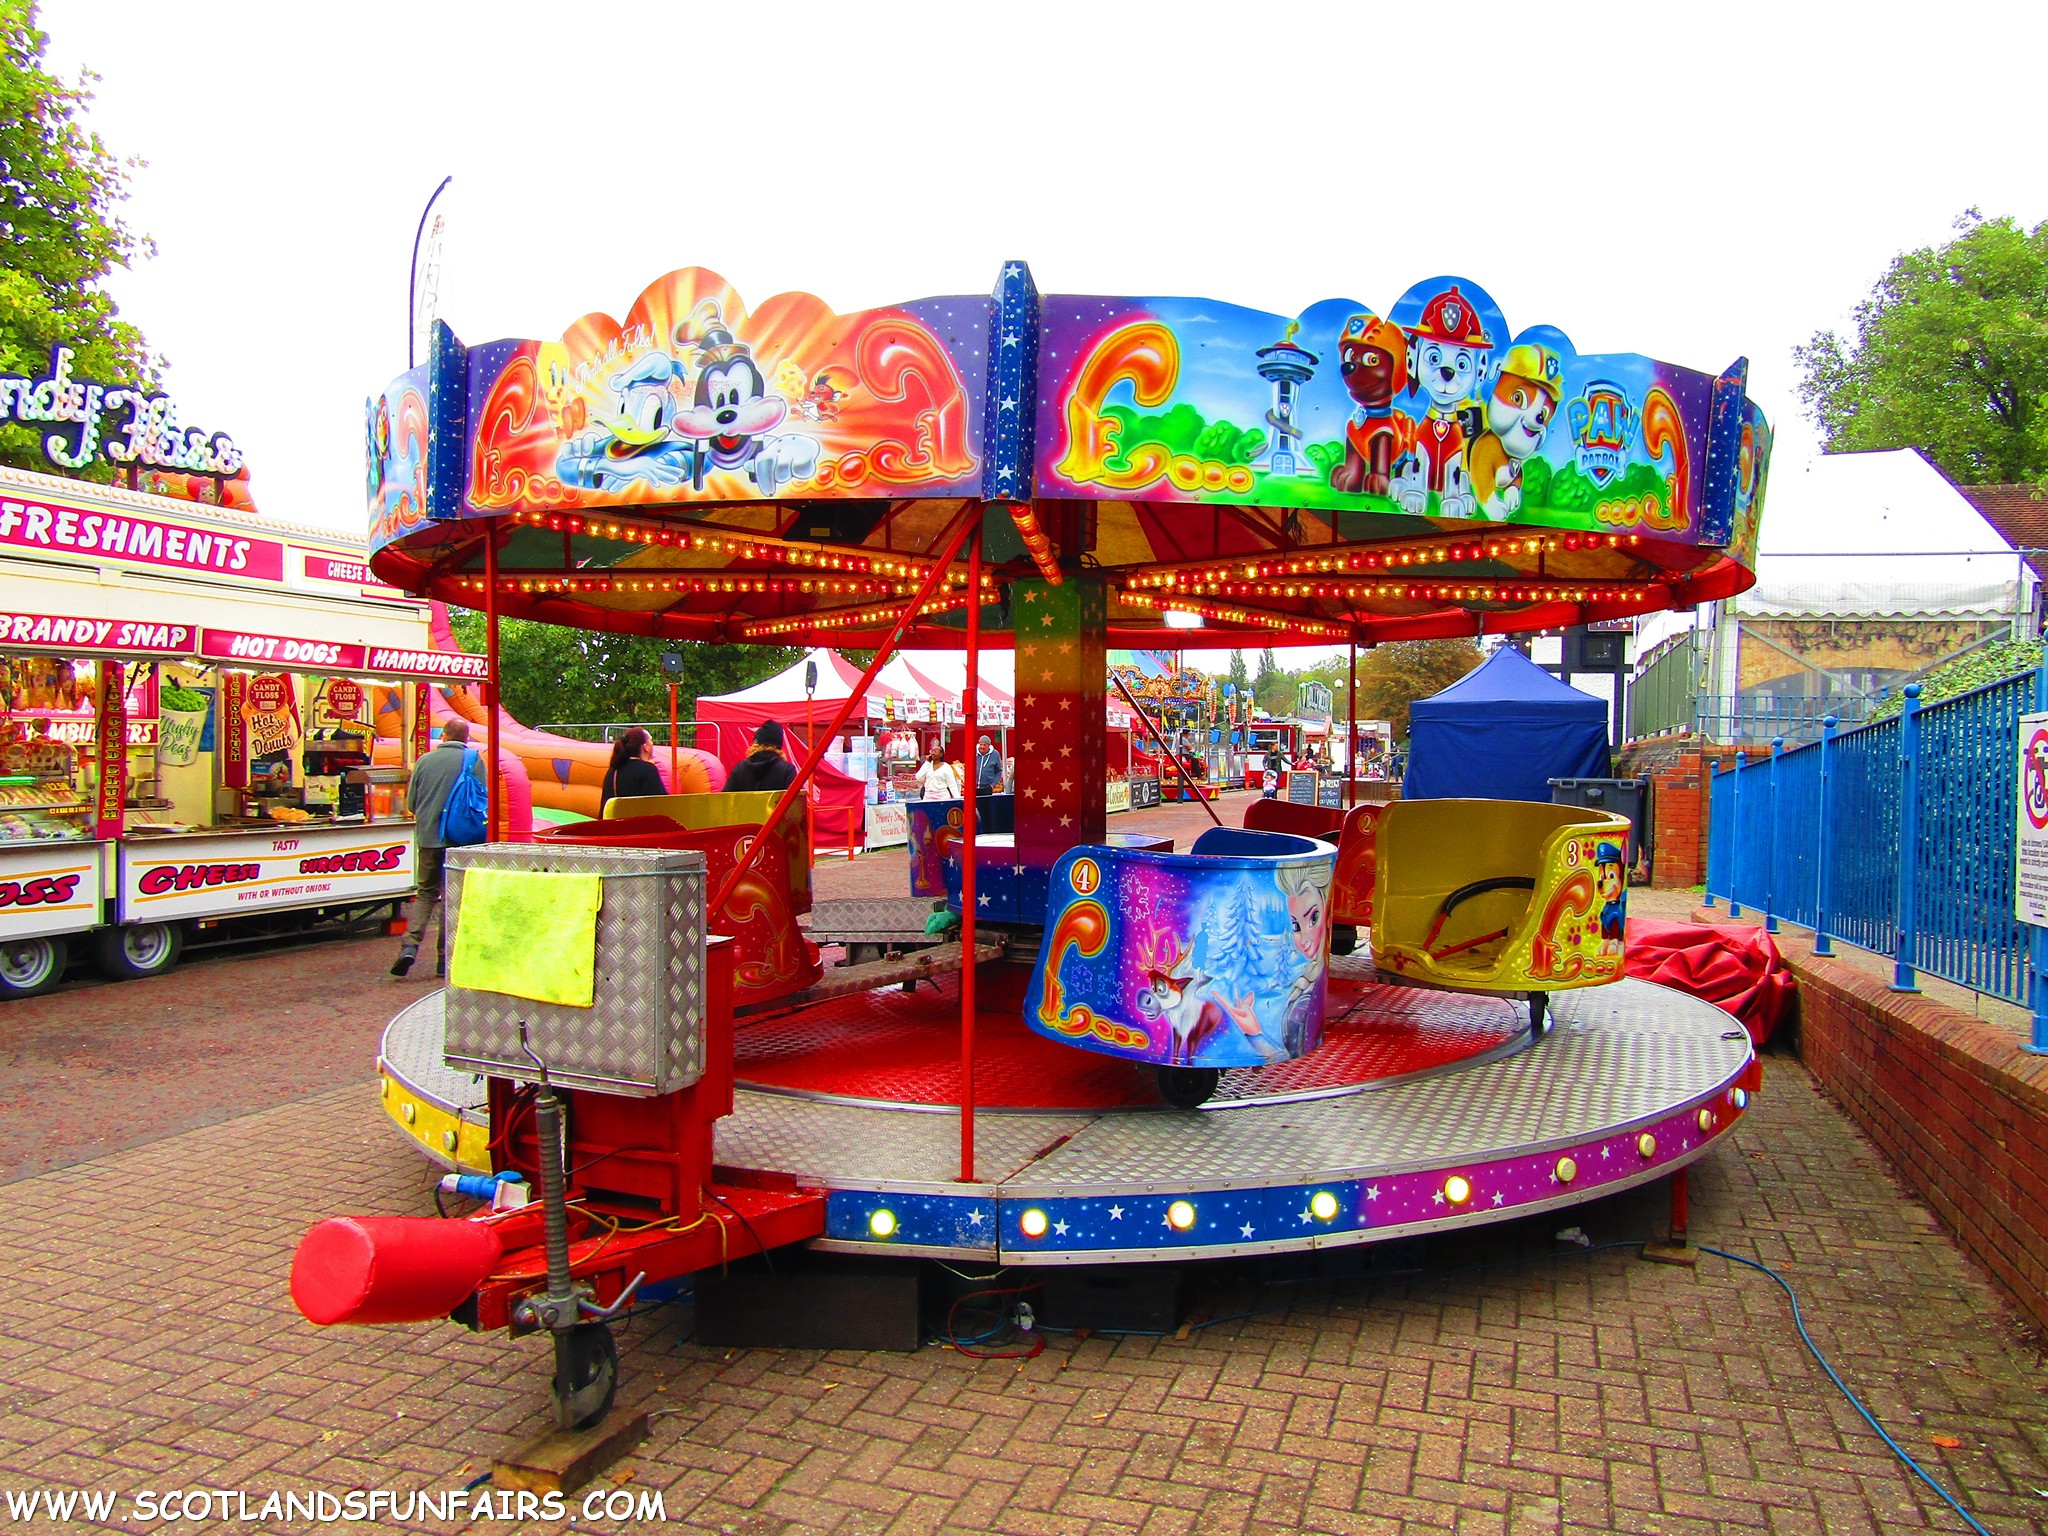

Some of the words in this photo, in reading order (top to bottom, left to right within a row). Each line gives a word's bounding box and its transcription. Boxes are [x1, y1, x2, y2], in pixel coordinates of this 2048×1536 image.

[1567, 397, 1641, 450] PAW
[327, 561, 363, 580] CHEESE
[117, 623, 188, 649] SNAP
[231, 634, 279, 659] HOT
[282, 640, 342, 665] DOGS
[253, 683, 281, 692] CANDY
[255, 691, 280, 700] FLOSS
[333, 686, 358, 694] CANDY
[334, 693, 356, 701] FLOSS
[230, 699, 241, 727] COLD
[252, 713, 275, 731] Hot
[160, 714, 199, 744] Mushy
[260, 718, 287, 741] Fresh
[160, 732, 191, 760] Peas
[230, 727, 241, 762] SLUSH
[252, 735, 294, 757] Donuts
[953, 811, 958, 824] 1
[1363, 815, 1371, 833] 2
[271, 840, 299, 851] TASTY
[1568, 841, 1577, 866] 3
[138, 863, 261, 895] CHEESE
[299, 845, 406, 874] BURGERS
[1076, 864, 1091, 891] 4
[237, 892, 258, 901] WITH
[259, 890, 270, 899] OR
[271, 887, 303, 898] WITHOUT
[305, 883, 331, 894] ONIONS
